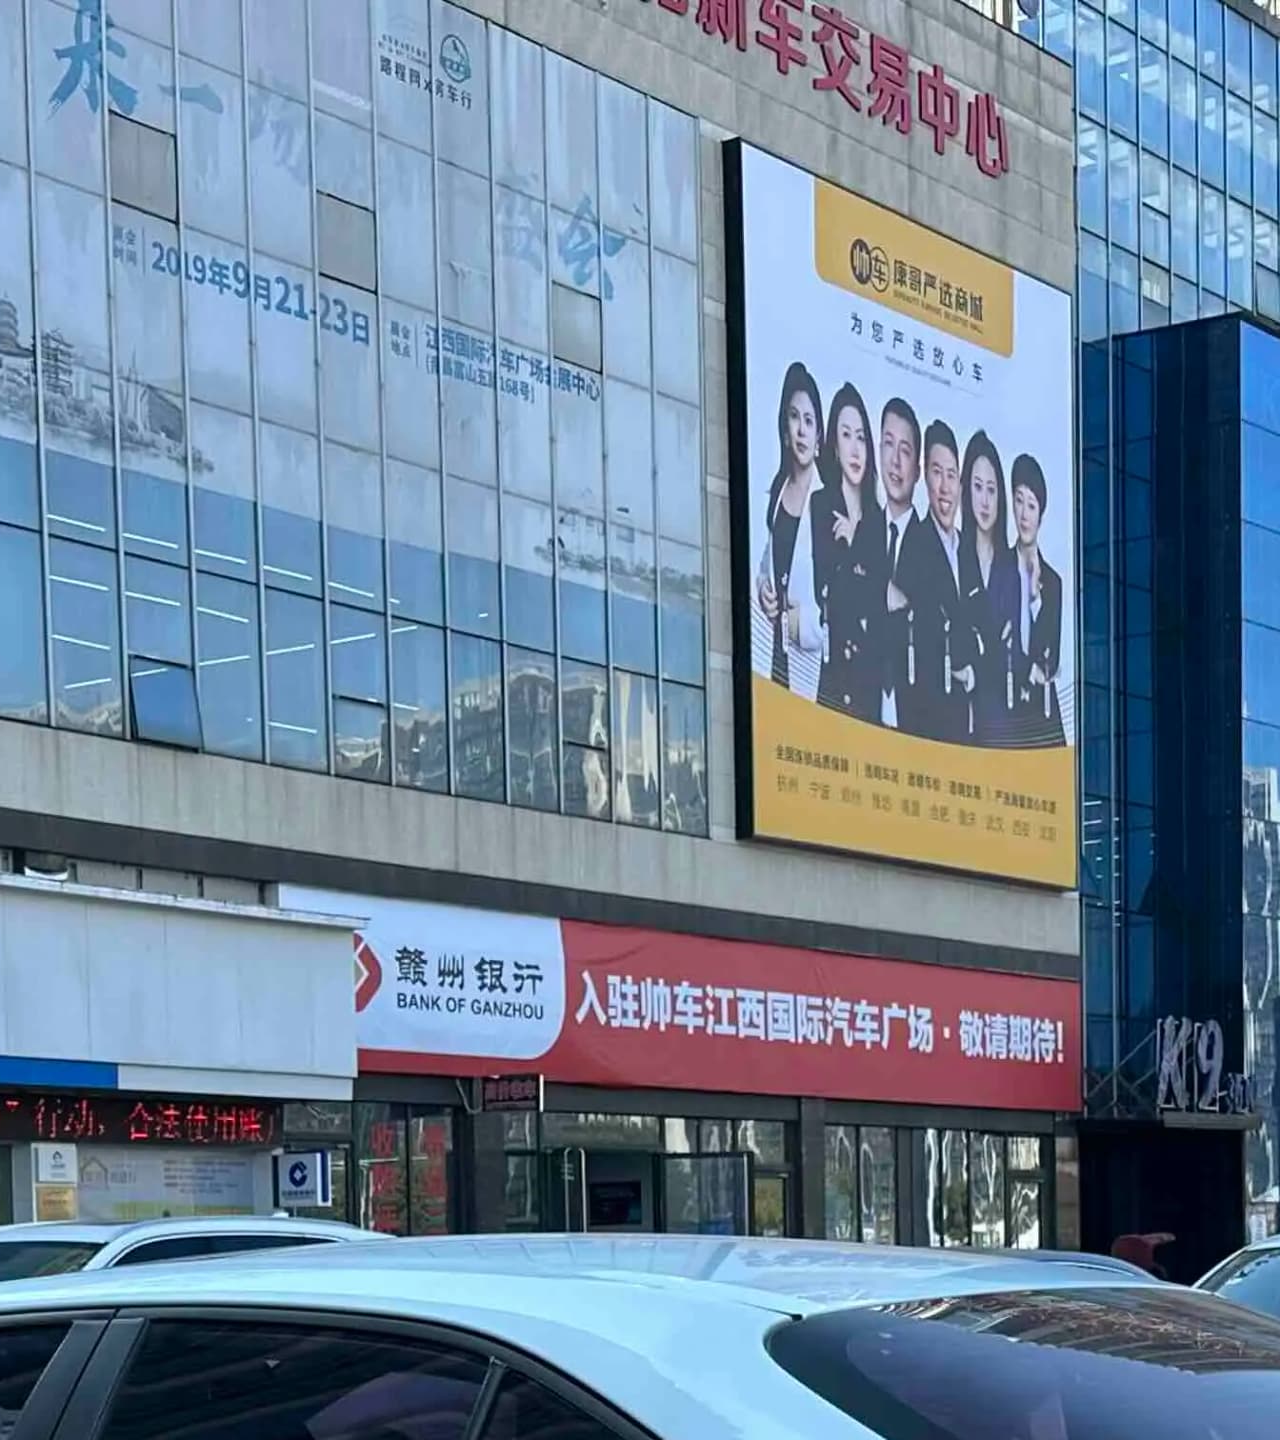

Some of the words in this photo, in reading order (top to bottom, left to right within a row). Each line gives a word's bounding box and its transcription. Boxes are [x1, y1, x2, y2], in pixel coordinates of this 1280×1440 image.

[395, 946, 544, 996] 赣州银行
[396, 993, 441, 1012] BANK
[446, 996, 466, 1014] OF
[471, 998, 544, 1020] GANZHOU
